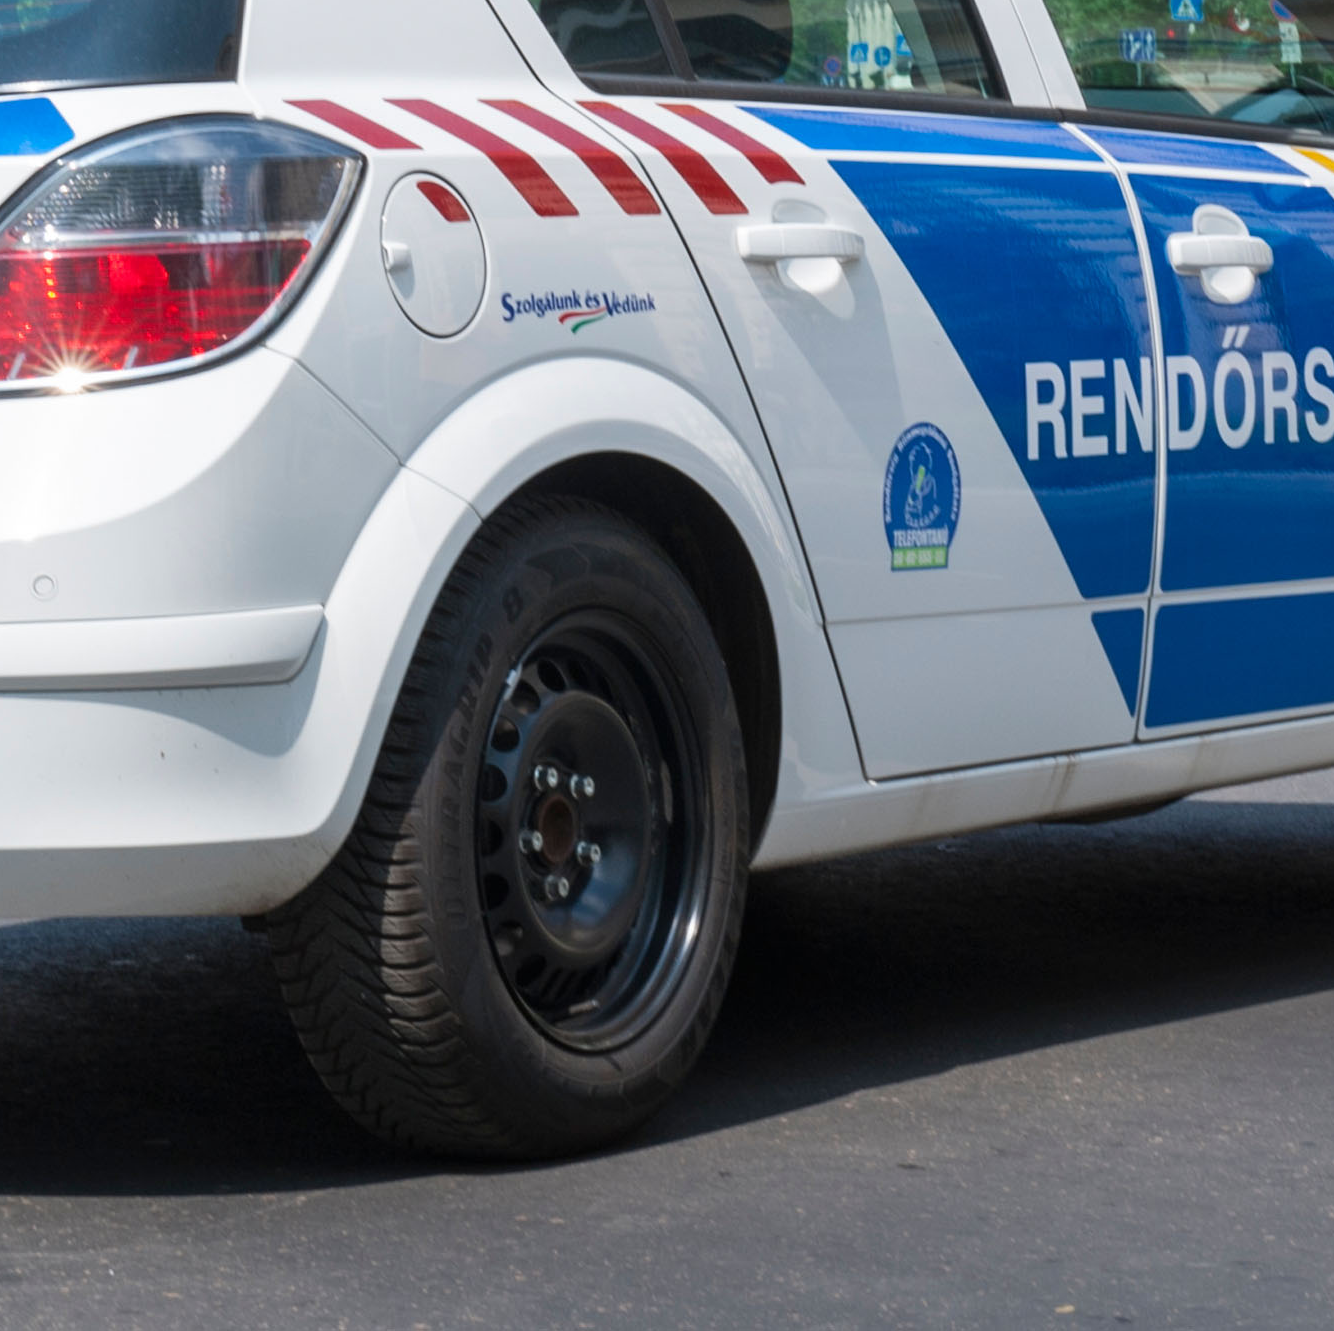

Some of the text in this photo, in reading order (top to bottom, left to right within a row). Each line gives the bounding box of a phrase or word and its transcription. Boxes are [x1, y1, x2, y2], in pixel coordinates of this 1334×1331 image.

[501, 289, 656, 322] Szolgálunk és Védünk
